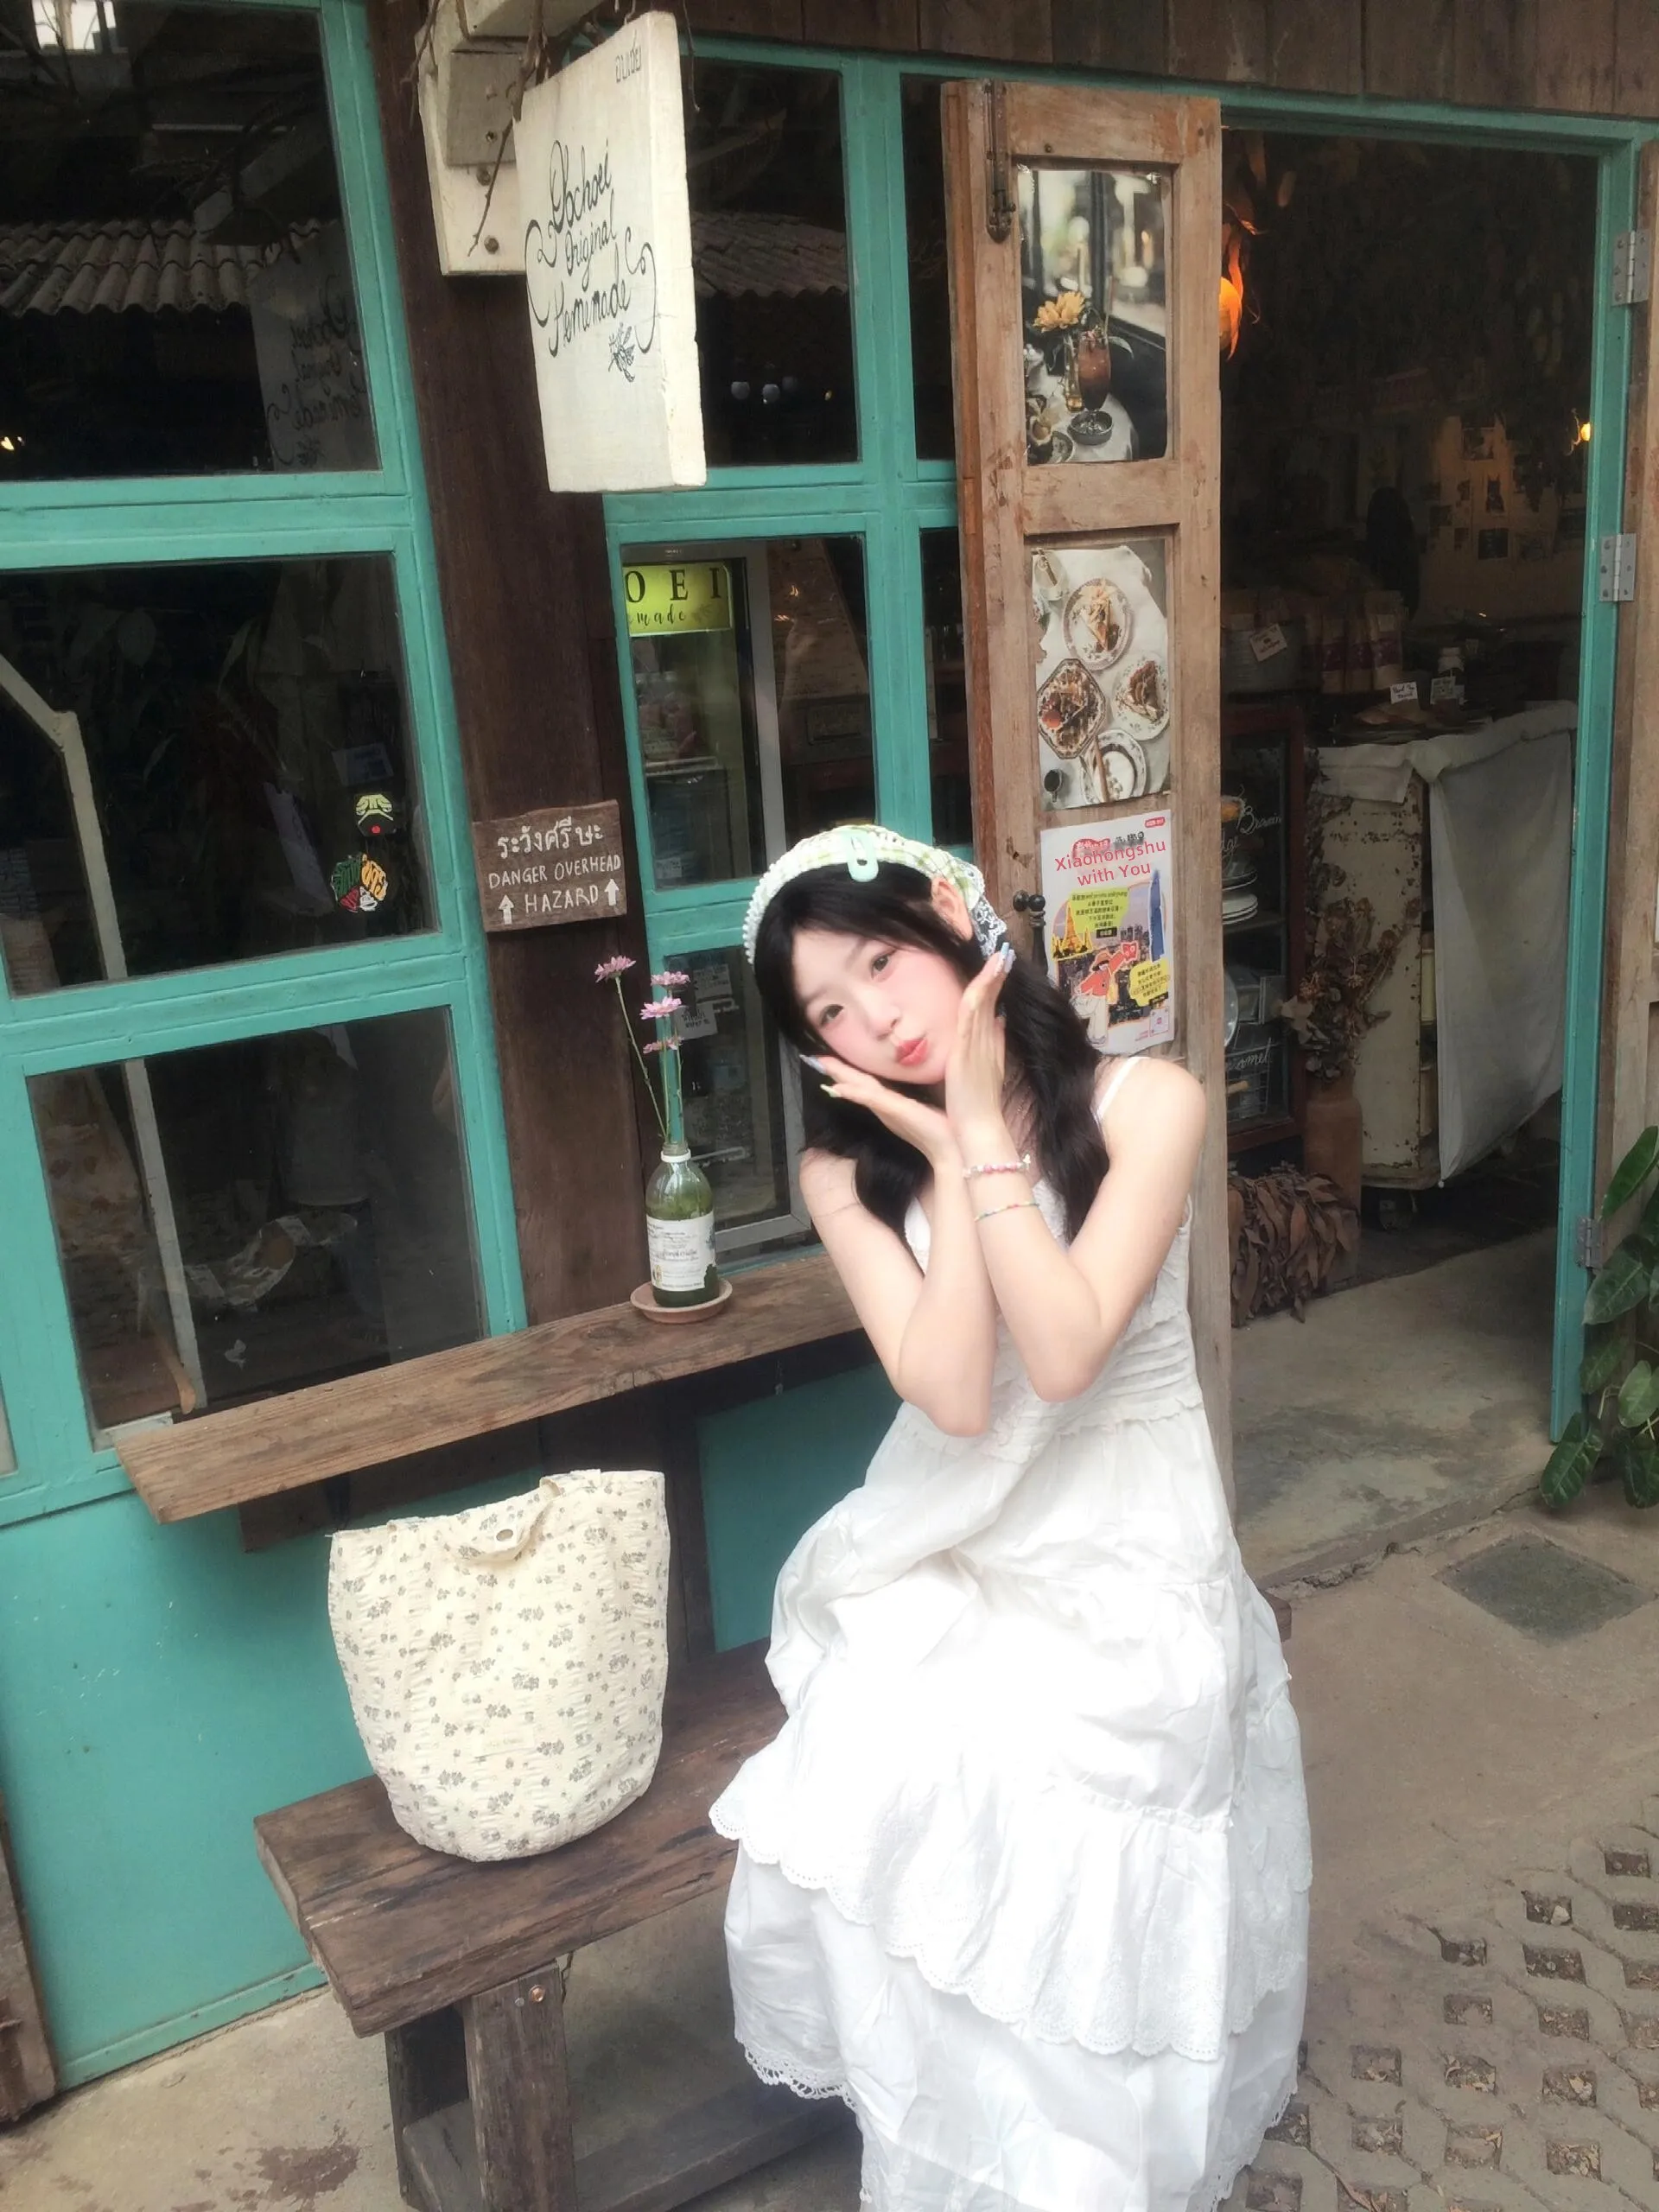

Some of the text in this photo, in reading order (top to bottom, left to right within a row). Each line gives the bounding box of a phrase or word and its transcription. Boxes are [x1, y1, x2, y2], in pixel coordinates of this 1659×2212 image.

[564, 188, 617, 292] Original
[628, 603, 687, 626] made
[1054, 841, 1166, 872] Xiaohongshu
[488, 855, 622, 890] DANGER OVERHEAD
[1077, 862, 1151, 887] with You
[524, 885, 599, 914] HAZARD
